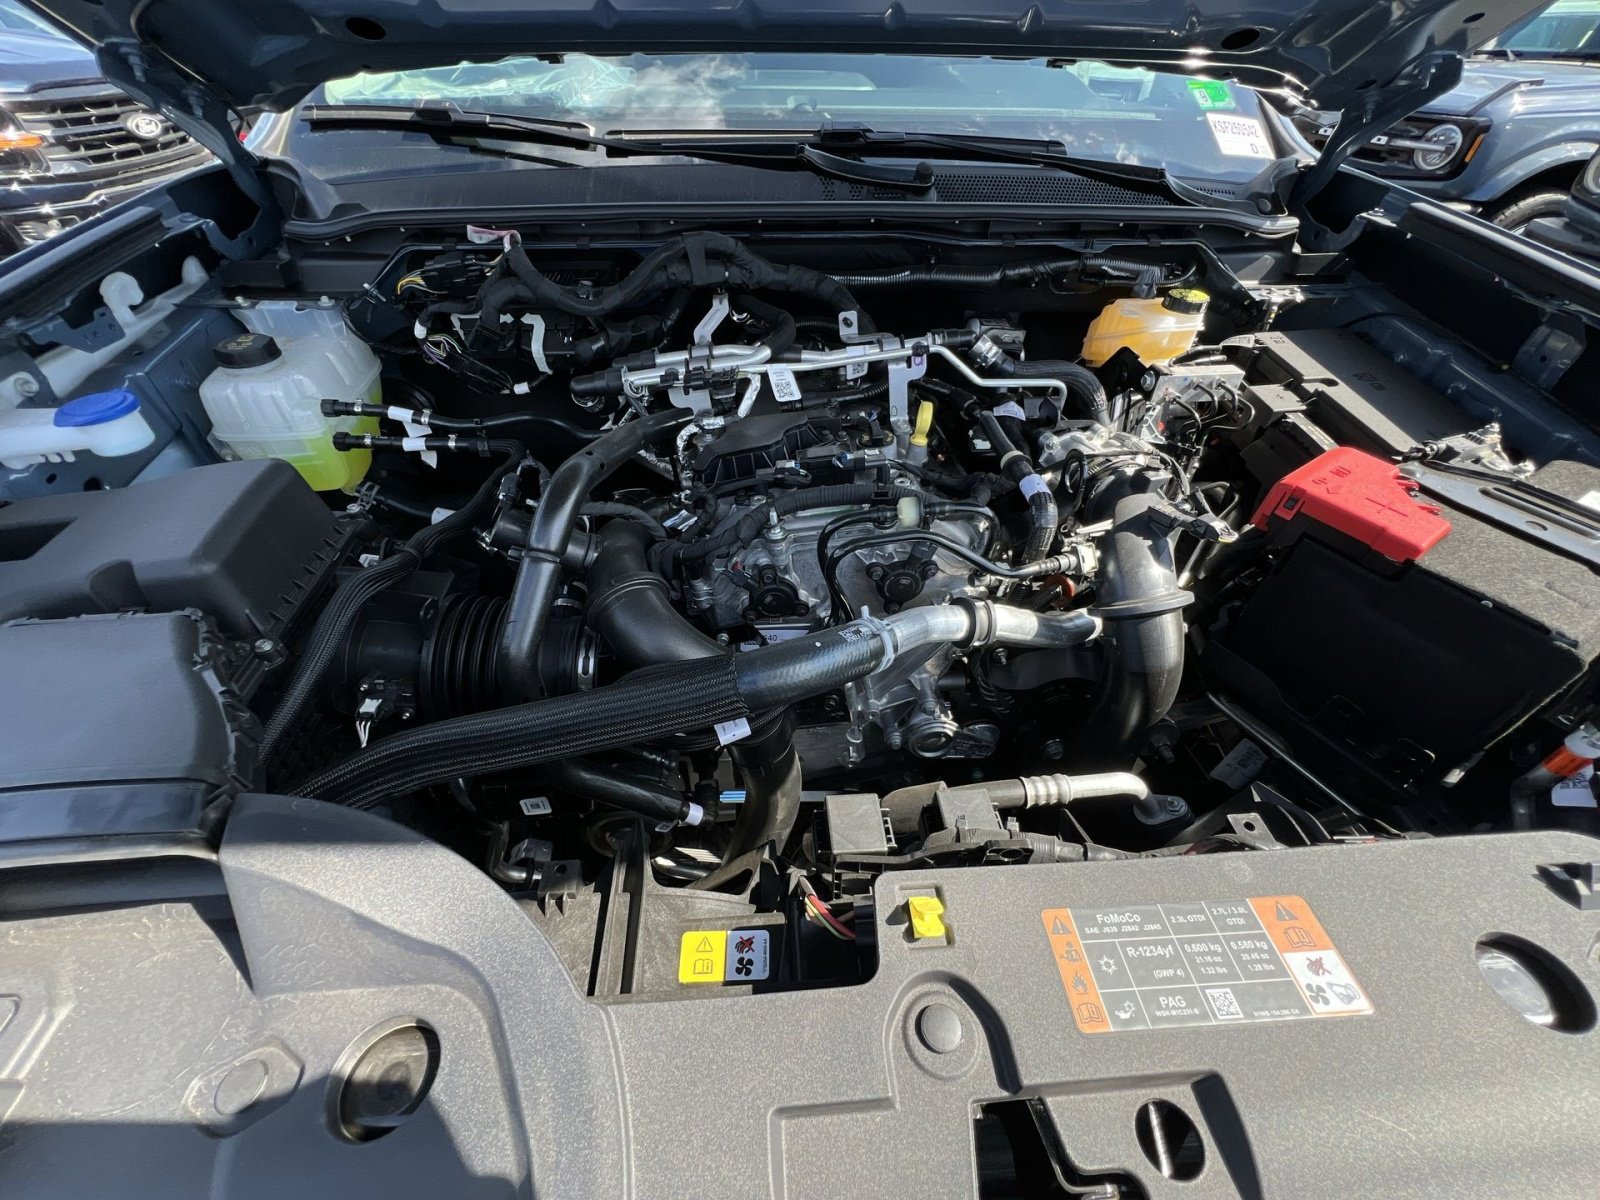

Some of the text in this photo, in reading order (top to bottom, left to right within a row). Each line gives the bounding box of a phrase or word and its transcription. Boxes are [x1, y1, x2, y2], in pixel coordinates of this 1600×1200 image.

[1096, 913, 1141, 924] FoMoCo
[1187, 914, 1207, 922] GTDI
[1226, 917, 1246, 925] GTDI
[1208, 942, 1222, 954] kg
[1254, 939, 1268, 950] kg
[1126, 945, 1174, 958] R-1234yf
[1215, 965, 1228, 974] lbs
[1262, 962, 1275, 970] lbs
[1159, 996, 1186, 1008] PAG
